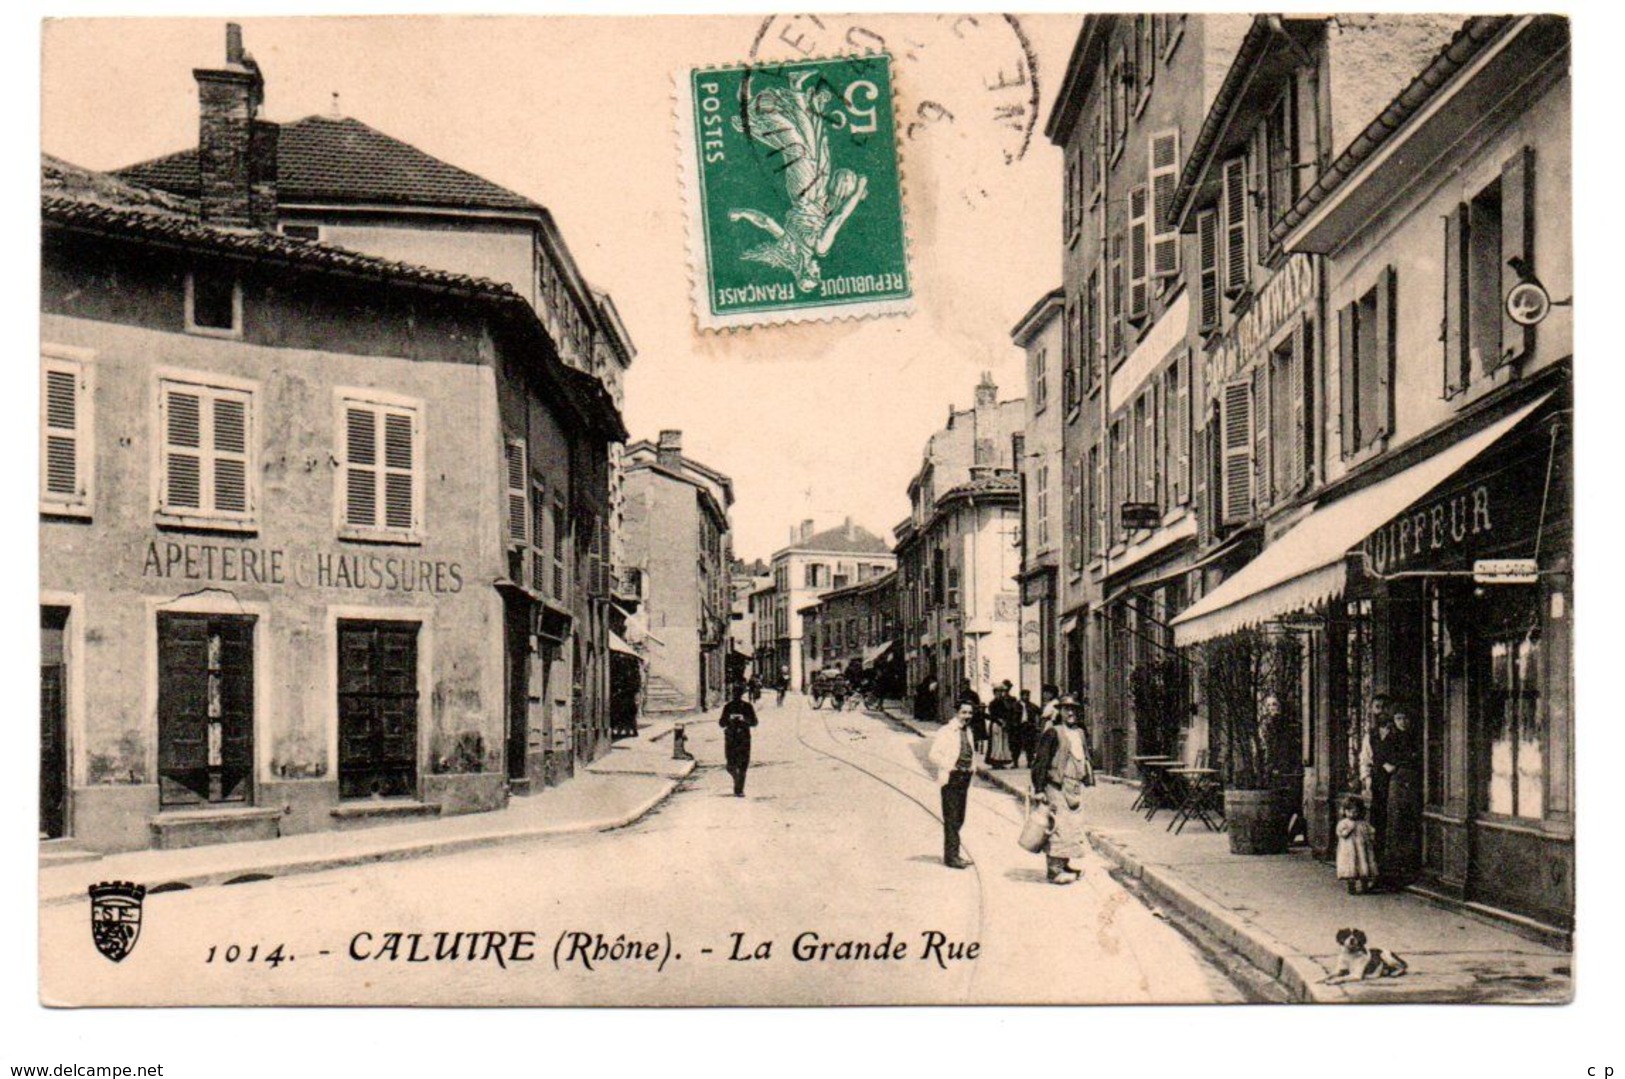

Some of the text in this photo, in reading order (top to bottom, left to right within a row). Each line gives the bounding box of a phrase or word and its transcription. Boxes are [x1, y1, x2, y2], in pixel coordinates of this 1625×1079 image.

[701, 82, 724, 163] POSTES
[719, 273, 904, 306] REPUBLIQUE FRANÇAISE
